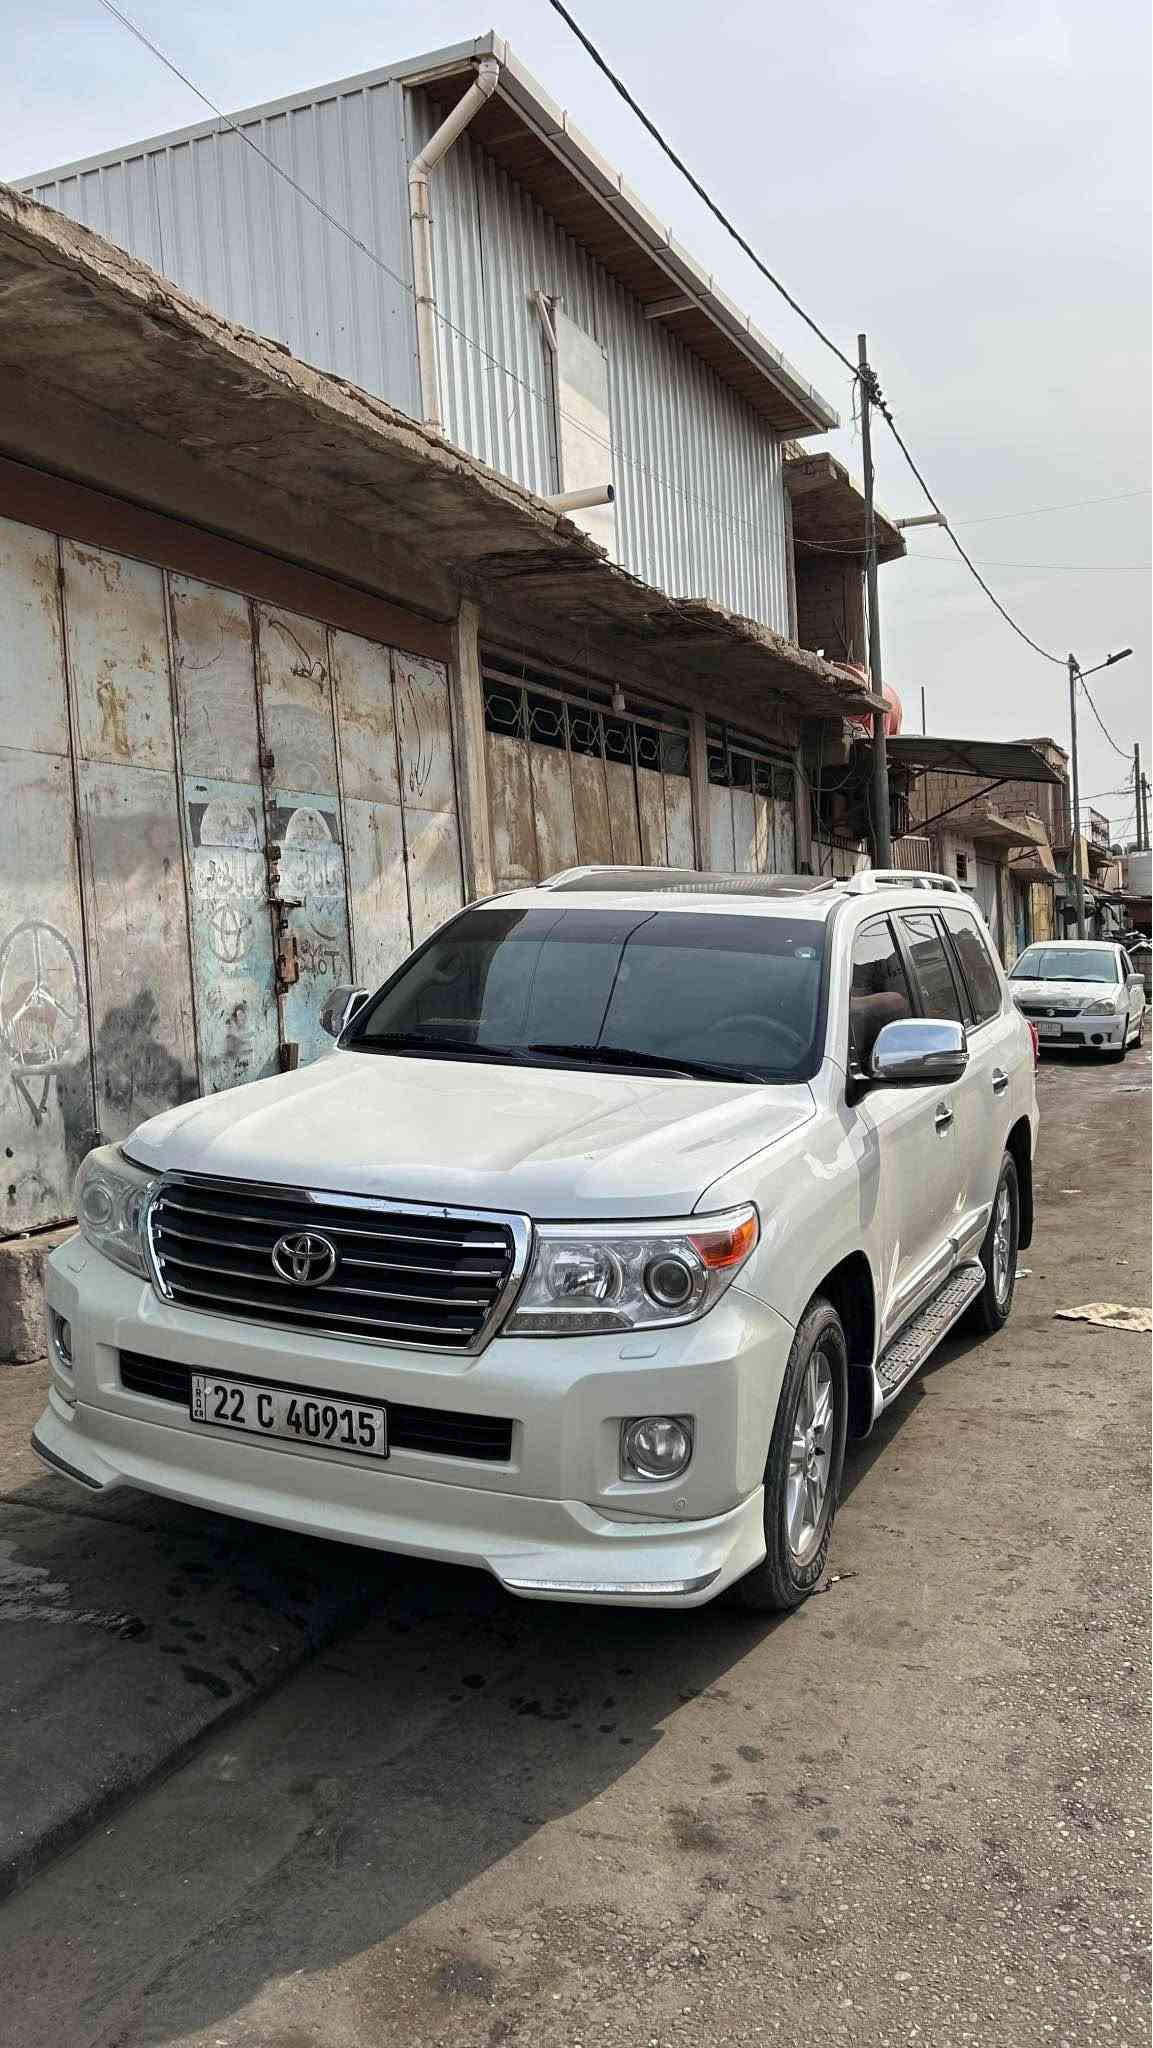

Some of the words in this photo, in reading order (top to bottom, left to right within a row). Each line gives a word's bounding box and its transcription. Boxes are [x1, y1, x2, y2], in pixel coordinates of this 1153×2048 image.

[214, 1385, 245, 1423] 22
[257, 1394, 274, 1428] C
[286, 1400, 376, 1447] 40915
